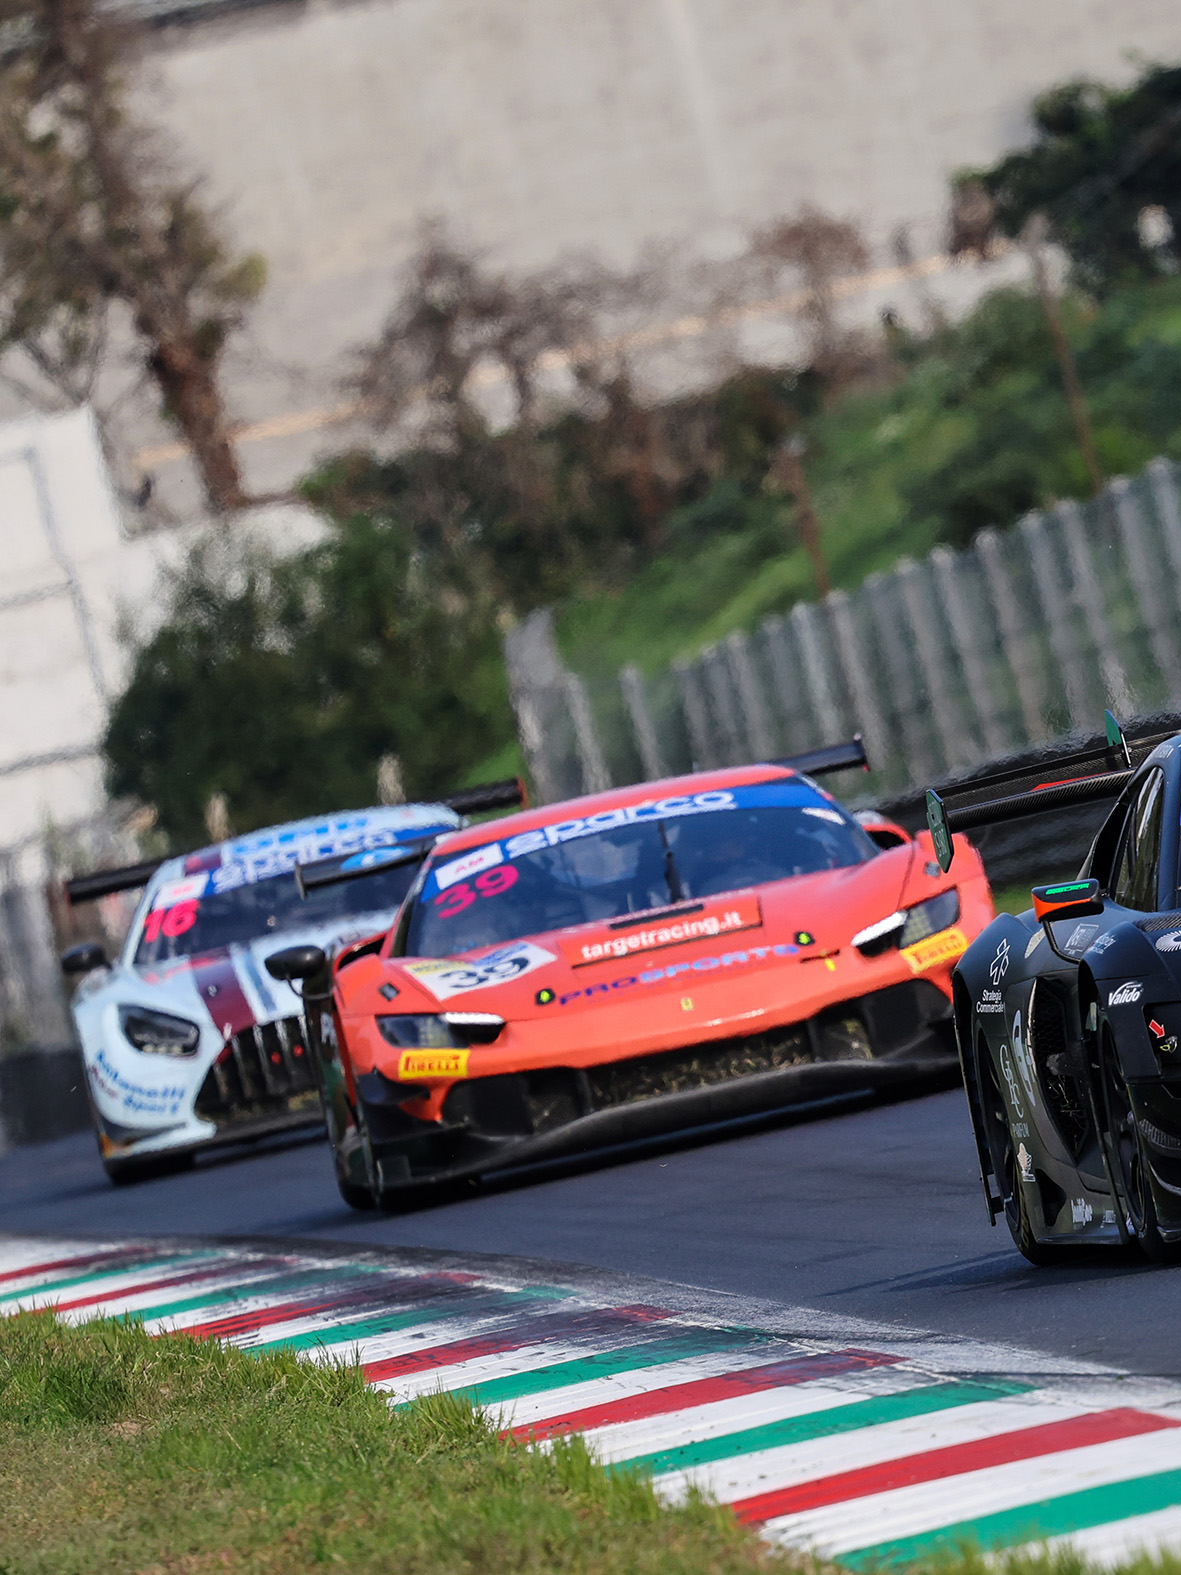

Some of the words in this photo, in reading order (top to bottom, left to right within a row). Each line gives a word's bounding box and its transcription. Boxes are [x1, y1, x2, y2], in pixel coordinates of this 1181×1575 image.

[505, 791, 737, 860] sparco
[434, 865, 519, 919] 39
[144, 899, 200, 943] 16
[581, 910, 743, 960] targetracing.it
[439, 957, 530, 989] 39
[1108, 982, 1141, 1006] Valido
[404, 1054, 460, 1072] PIRELLI
